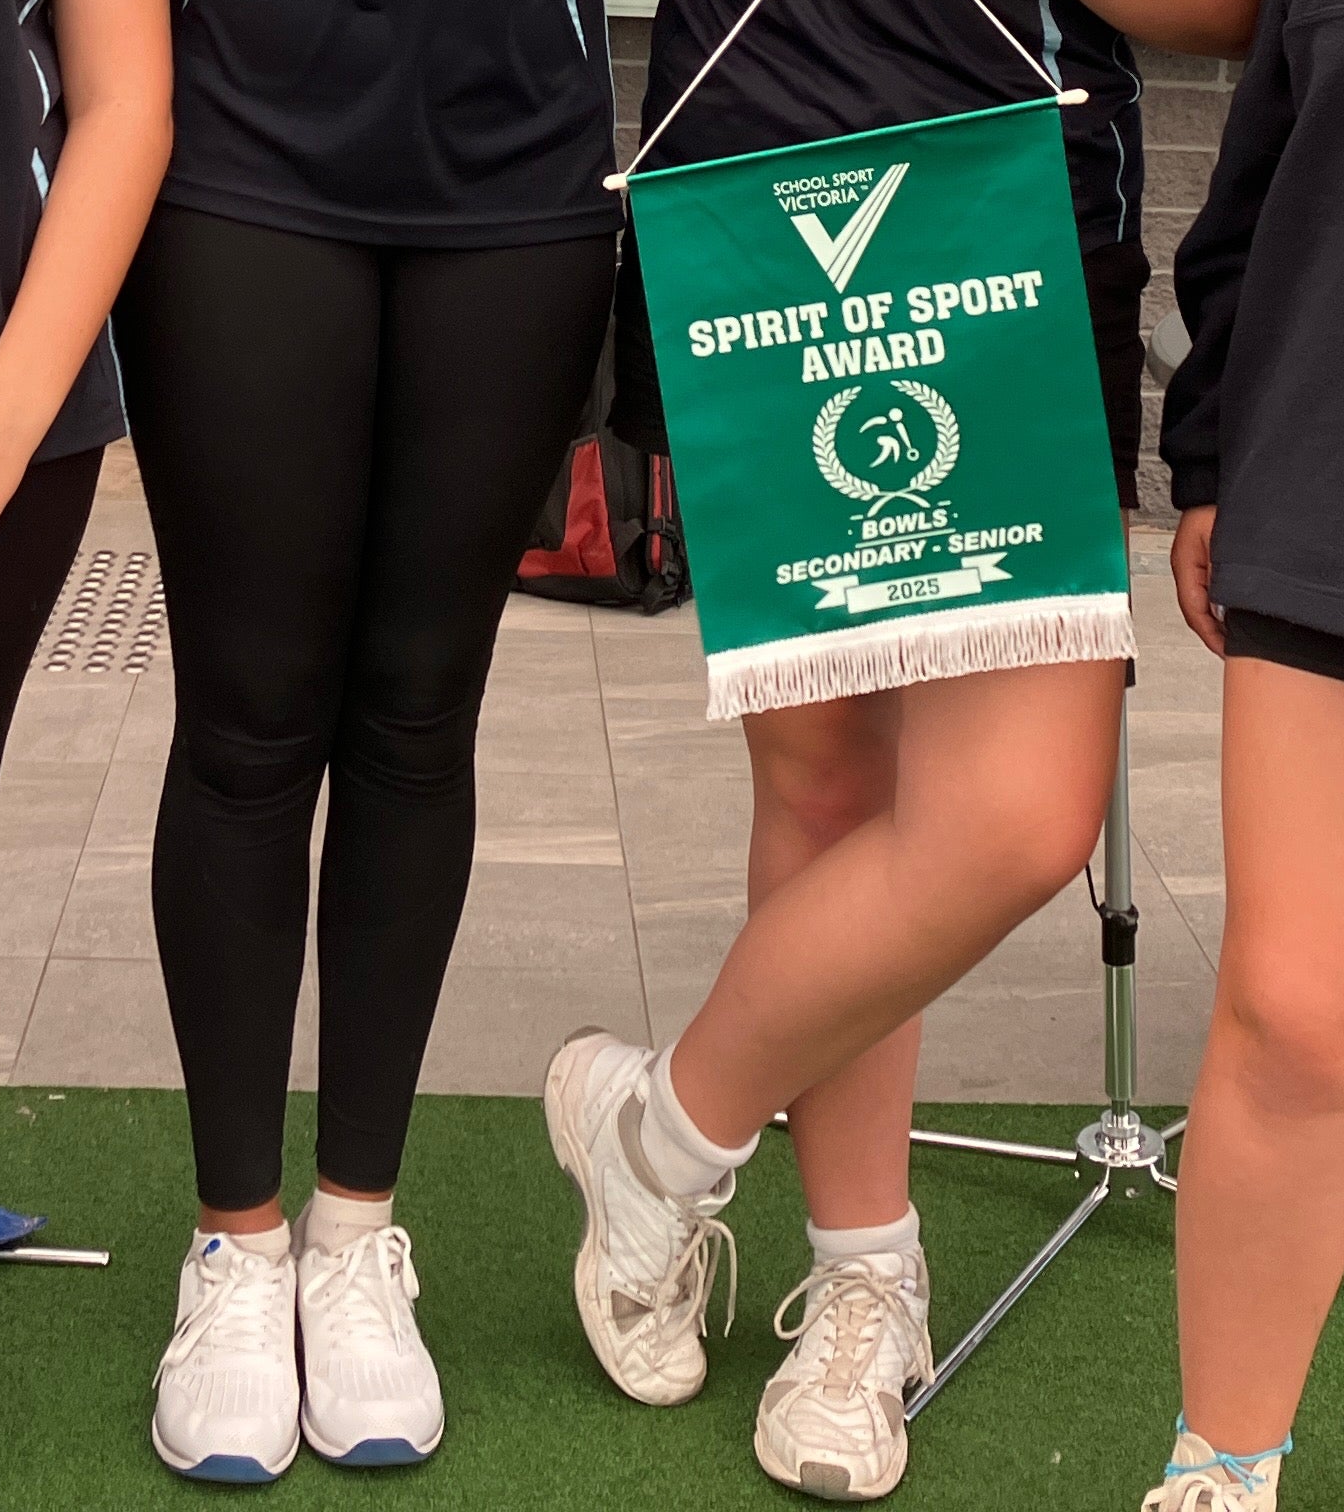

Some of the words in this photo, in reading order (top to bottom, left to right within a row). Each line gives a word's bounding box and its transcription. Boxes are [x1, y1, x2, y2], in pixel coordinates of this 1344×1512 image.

[773, 178, 831, 196] SCHOOL
[832, 167, 875, 187] SPORT
[778, 188, 860, 213] VICTORIA
[688, 301, 829, 358] SPIRIT
[841, 291, 894, 333] OF
[906, 269, 1044, 324] SPORT
[801, 328, 947, 383] AWARD
[861, 508, 949, 541] BOWLS
[776, 539, 926, 584] SECONDARY
[948, 522, 1044, 555] SENIOR
[886, 577, 941, 602] 2025
